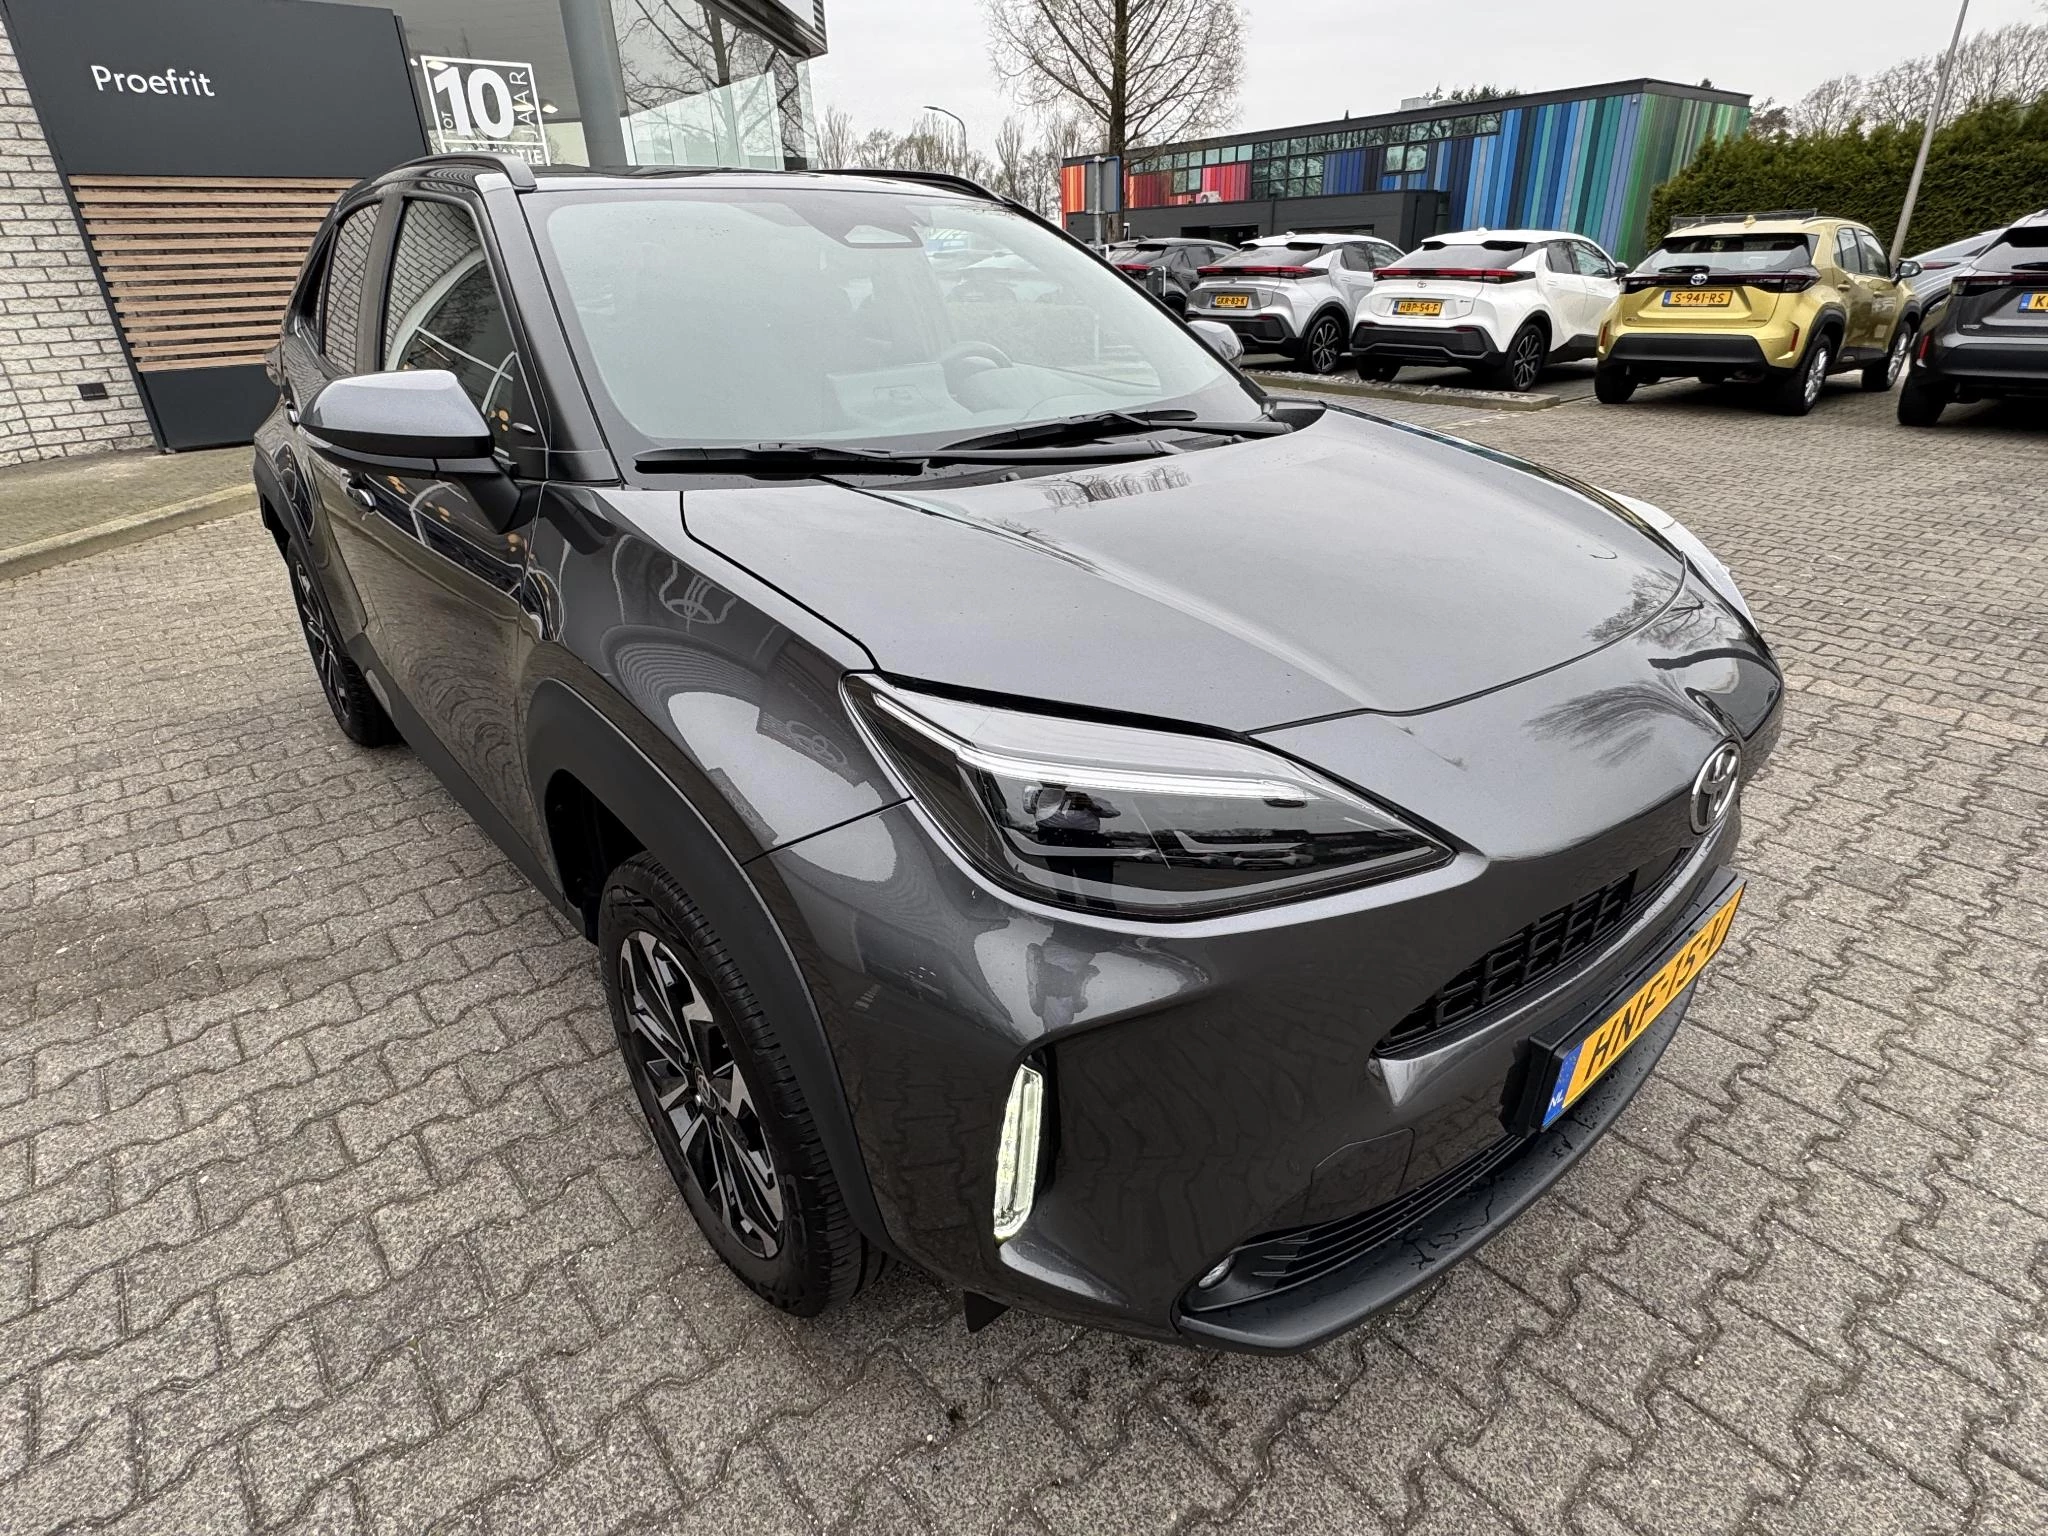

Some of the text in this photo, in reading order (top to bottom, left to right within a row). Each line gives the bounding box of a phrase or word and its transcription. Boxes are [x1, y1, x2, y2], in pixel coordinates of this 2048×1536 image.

[90, 65, 215, 97] Proefrit
[433, 66, 515, 139] 10
[508, 71, 540, 139] JAAR
[440, 111, 456, 136] TOT
[1399, 302, 1440, 313] HBP-54-F
[1674, 293, 1726, 304] S-941-RS
[1583, 906, 1732, 1082] HNF-15-V
